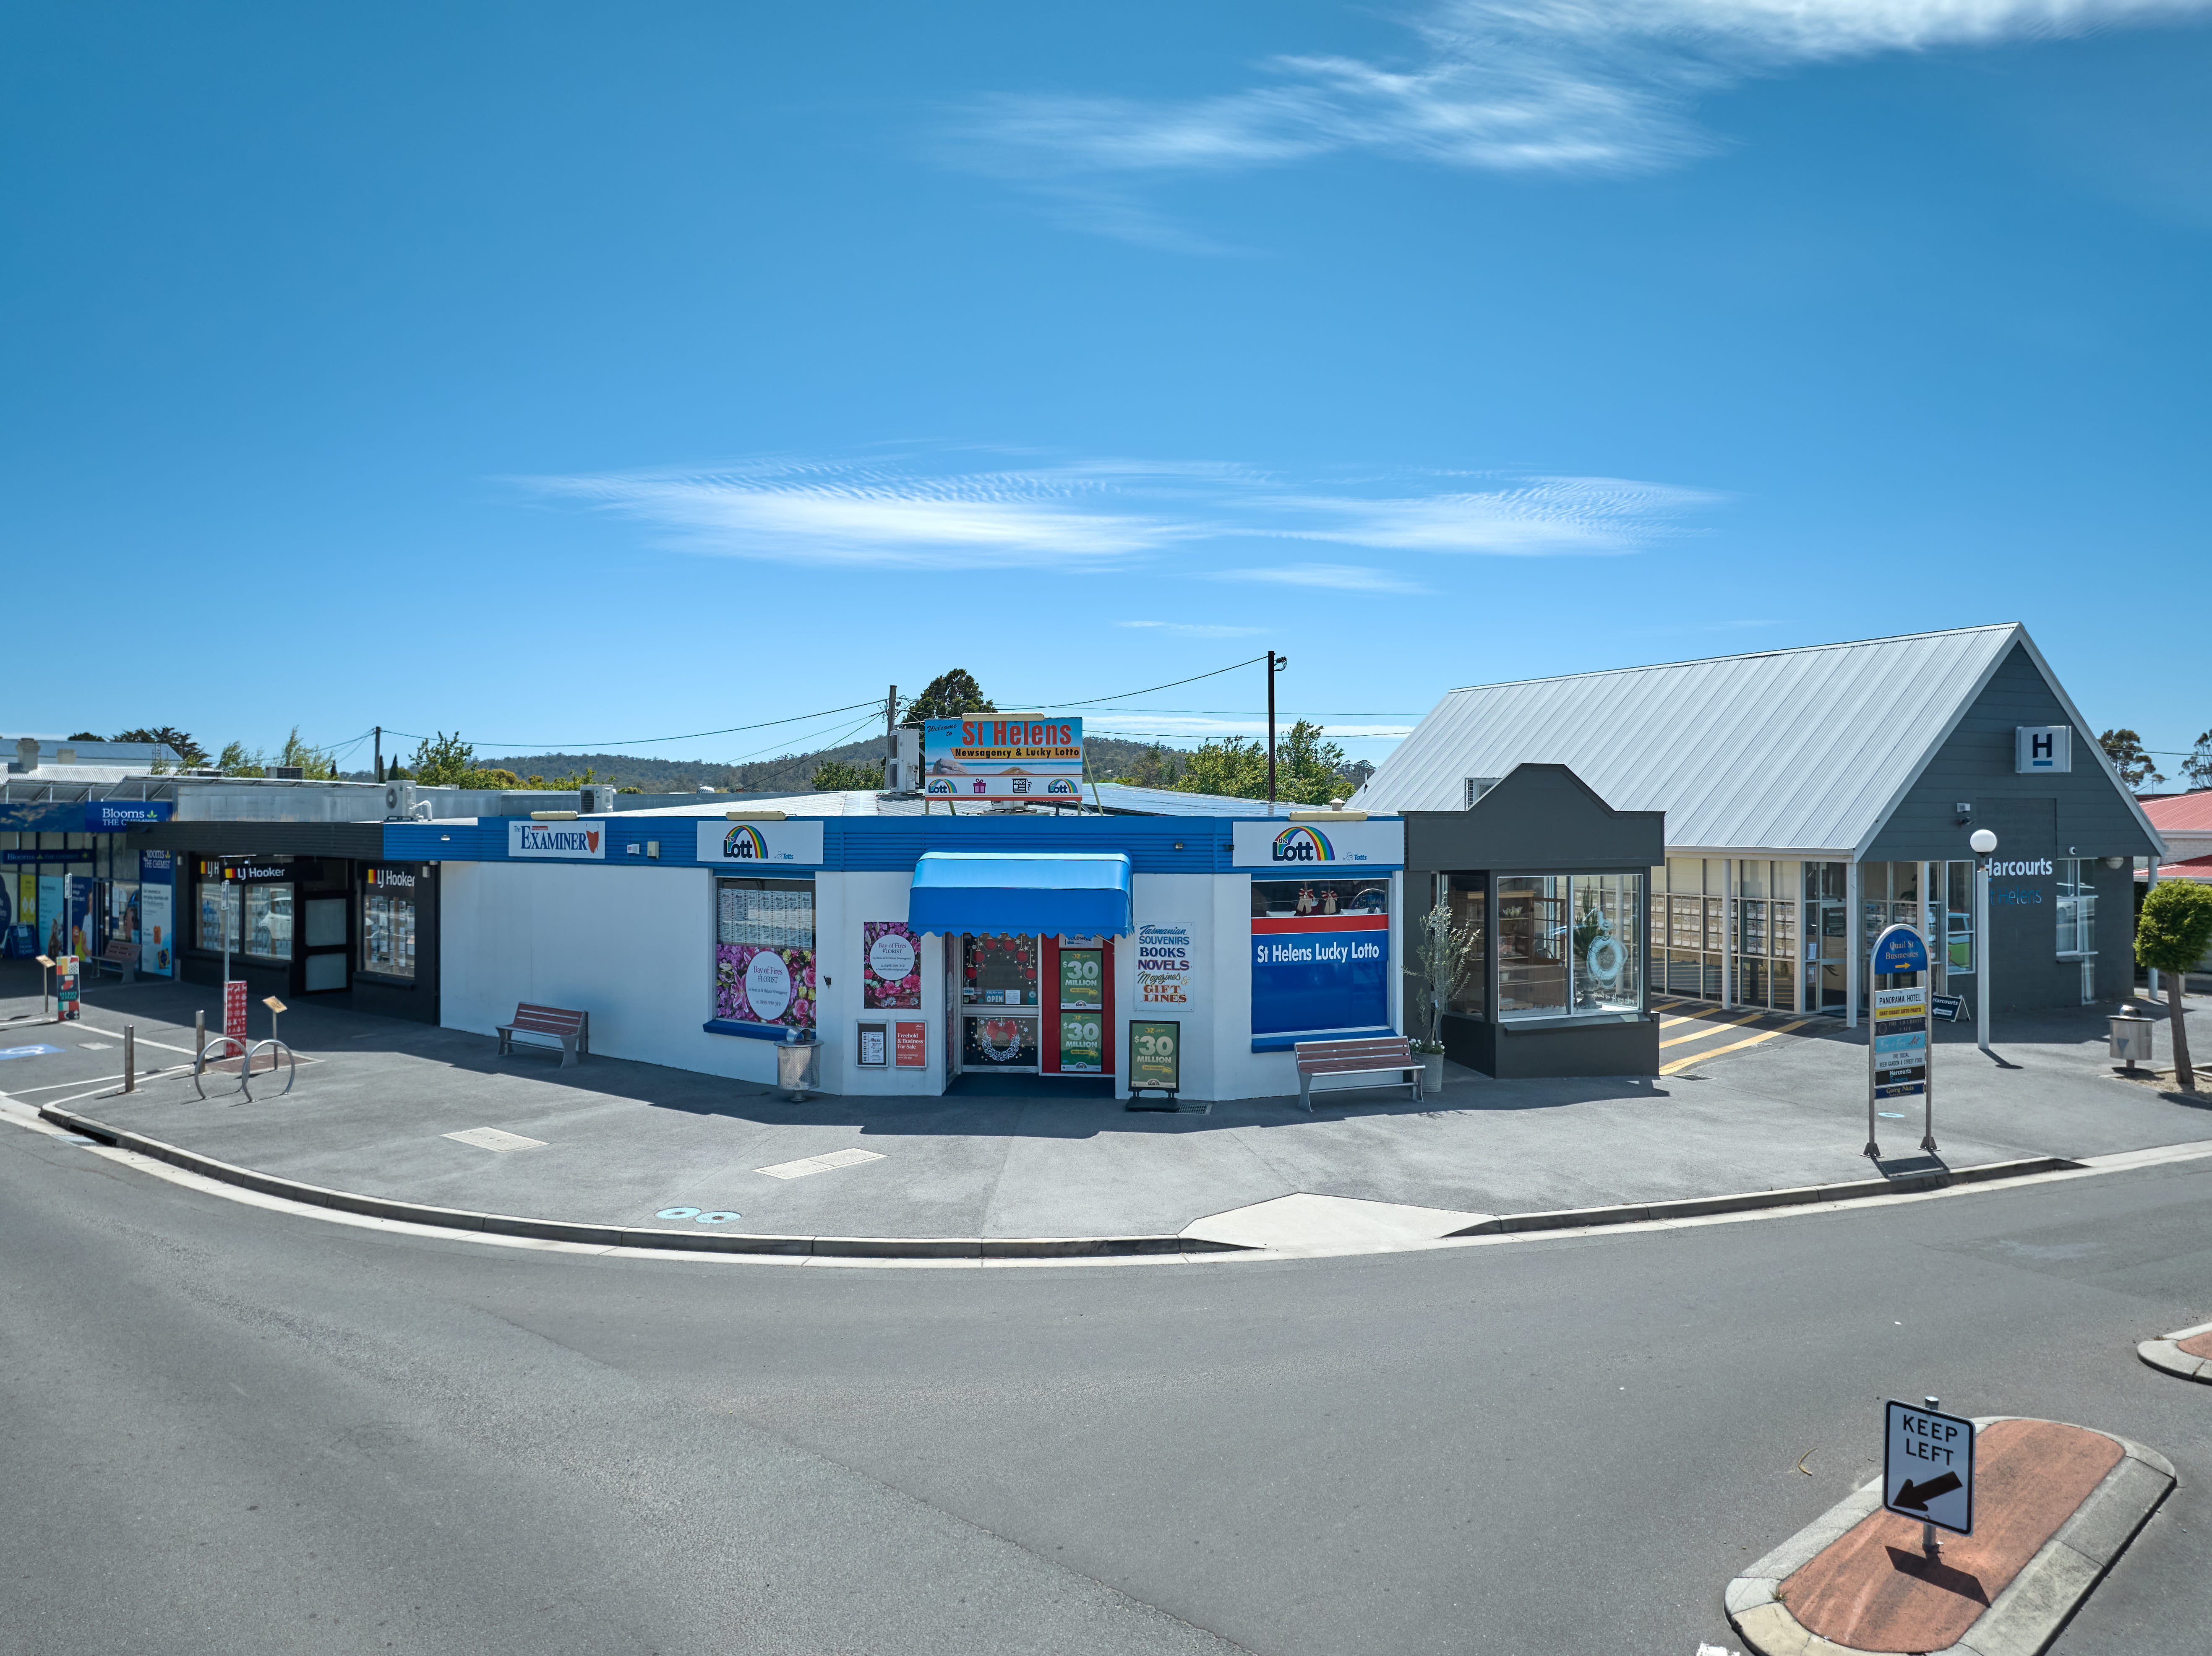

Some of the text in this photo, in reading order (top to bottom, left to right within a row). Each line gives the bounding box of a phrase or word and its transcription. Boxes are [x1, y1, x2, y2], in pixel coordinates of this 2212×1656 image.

[926, 724, 957, 733] Welcome
[962, 721, 1072, 745] St Helens
[2032, 733, 2052, 758] H
[955, 748, 1012, 758] Newsagency
[1026, 747, 1051, 758] Lucky
[928, 785, 947, 793] Lott
[1048, 785, 1068, 793] Lott
[102, 808, 145, 818] Blooms
[521, 825, 587, 851] EXAMINER
[723, 840, 753, 858] Lott
[1272, 841, 1314, 861] Lott
[153, 860, 170, 869] CHEMIST
[208, 862, 213, 877] LJ
[237, 867, 285, 880] LJ Hooker
[378, 870, 415, 888] LJ Hooker
[1998, 886, 2041, 905] Helens
[1140, 924, 1187, 935] Tasmanian
[1139, 936, 1189, 945] SOUVENIRS
[1889, 941, 1906, 950] Quail
[1140, 947, 1186, 958] BOOKS
[1257, 942, 1379, 963] St Helens Lucky Lotto
[1886, 951, 1919, 960] Businesses
[754, 965, 763, 975] Bay
[770, 967, 783, 975] Fires
[1137, 959, 1190, 971] NOVELS
[1137, 971, 1191, 986] Magazines &
[1143, 985, 1181, 993] GIFT
[1879, 994, 1921, 1005] PANORAMA HOTEL
[1903, 1414, 1958, 1442] KEEP
[1906, 1438, 1954, 1466] LEFT
